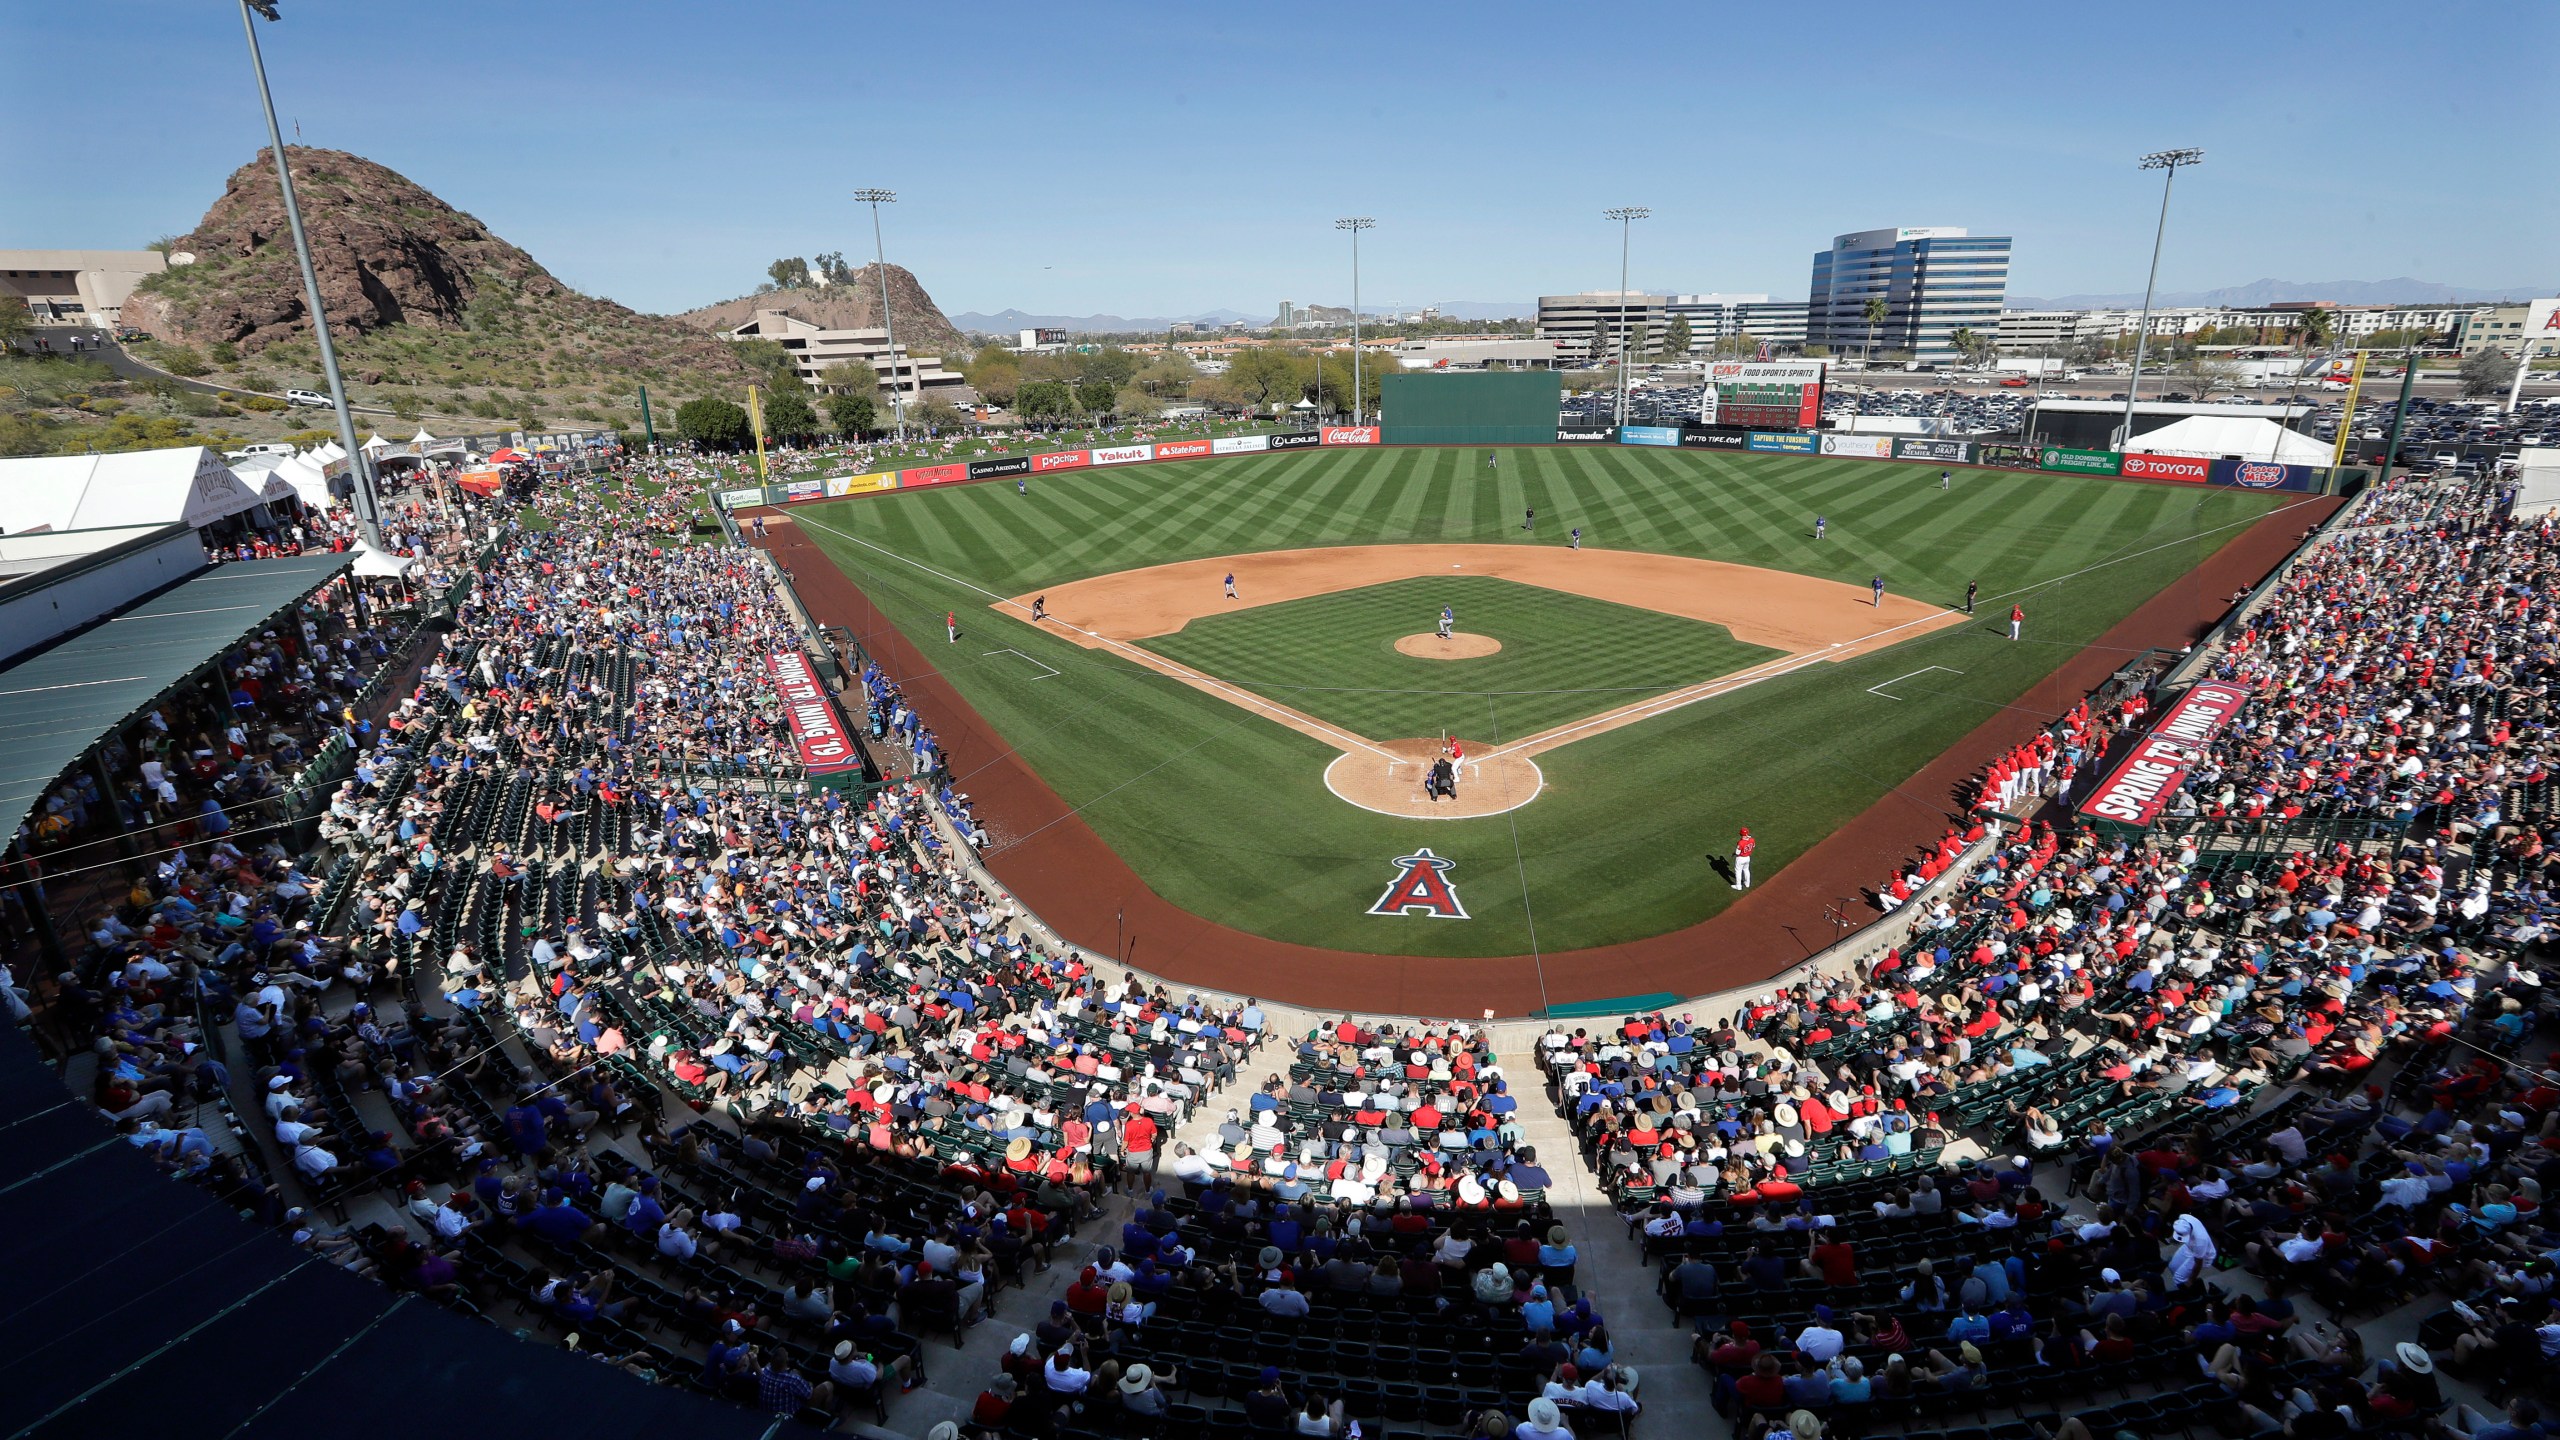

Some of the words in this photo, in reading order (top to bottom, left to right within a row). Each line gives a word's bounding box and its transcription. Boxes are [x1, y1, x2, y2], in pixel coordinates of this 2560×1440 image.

[1743, 369, 1761, 377] FOOD
[1761, 369, 1786, 377] SPORTS
[1787, 369, 1814, 378] SPIRITS
[1284, 436, 1318, 444] LEXUS
[1557, 430, 1605, 440] Thermador
[1685, 434, 1706, 442] NITTO
[1708, 436, 1742, 445] TIRE.COM
[1753, 434, 1774, 442] CAPTURE
[1775, 435, 1785, 443] THE
[1099, 449, 1145, 461] Yakult
[1934, 446, 1957, 455] DRAFT
[2060, 459, 2087, 467] FREIGHT
[971, 466, 994, 474] CASINO
[994, 464, 1021, 472] ARIZONA
[2148, 462, 2205, 477] TOYOTA
[2242, 463, 2281, 475] Jersey
[773, 653, 811, 686] SPRING
[2194, 690, 2234, 704] '19
[809, 737, 845, 756] '19
[2095, 759, 2176, 820] SPRING
[1365, 848, 1471, 919] A
[956, 1036, 967, 1047] 27
[1575, 1081, 1589, 1093] 30
